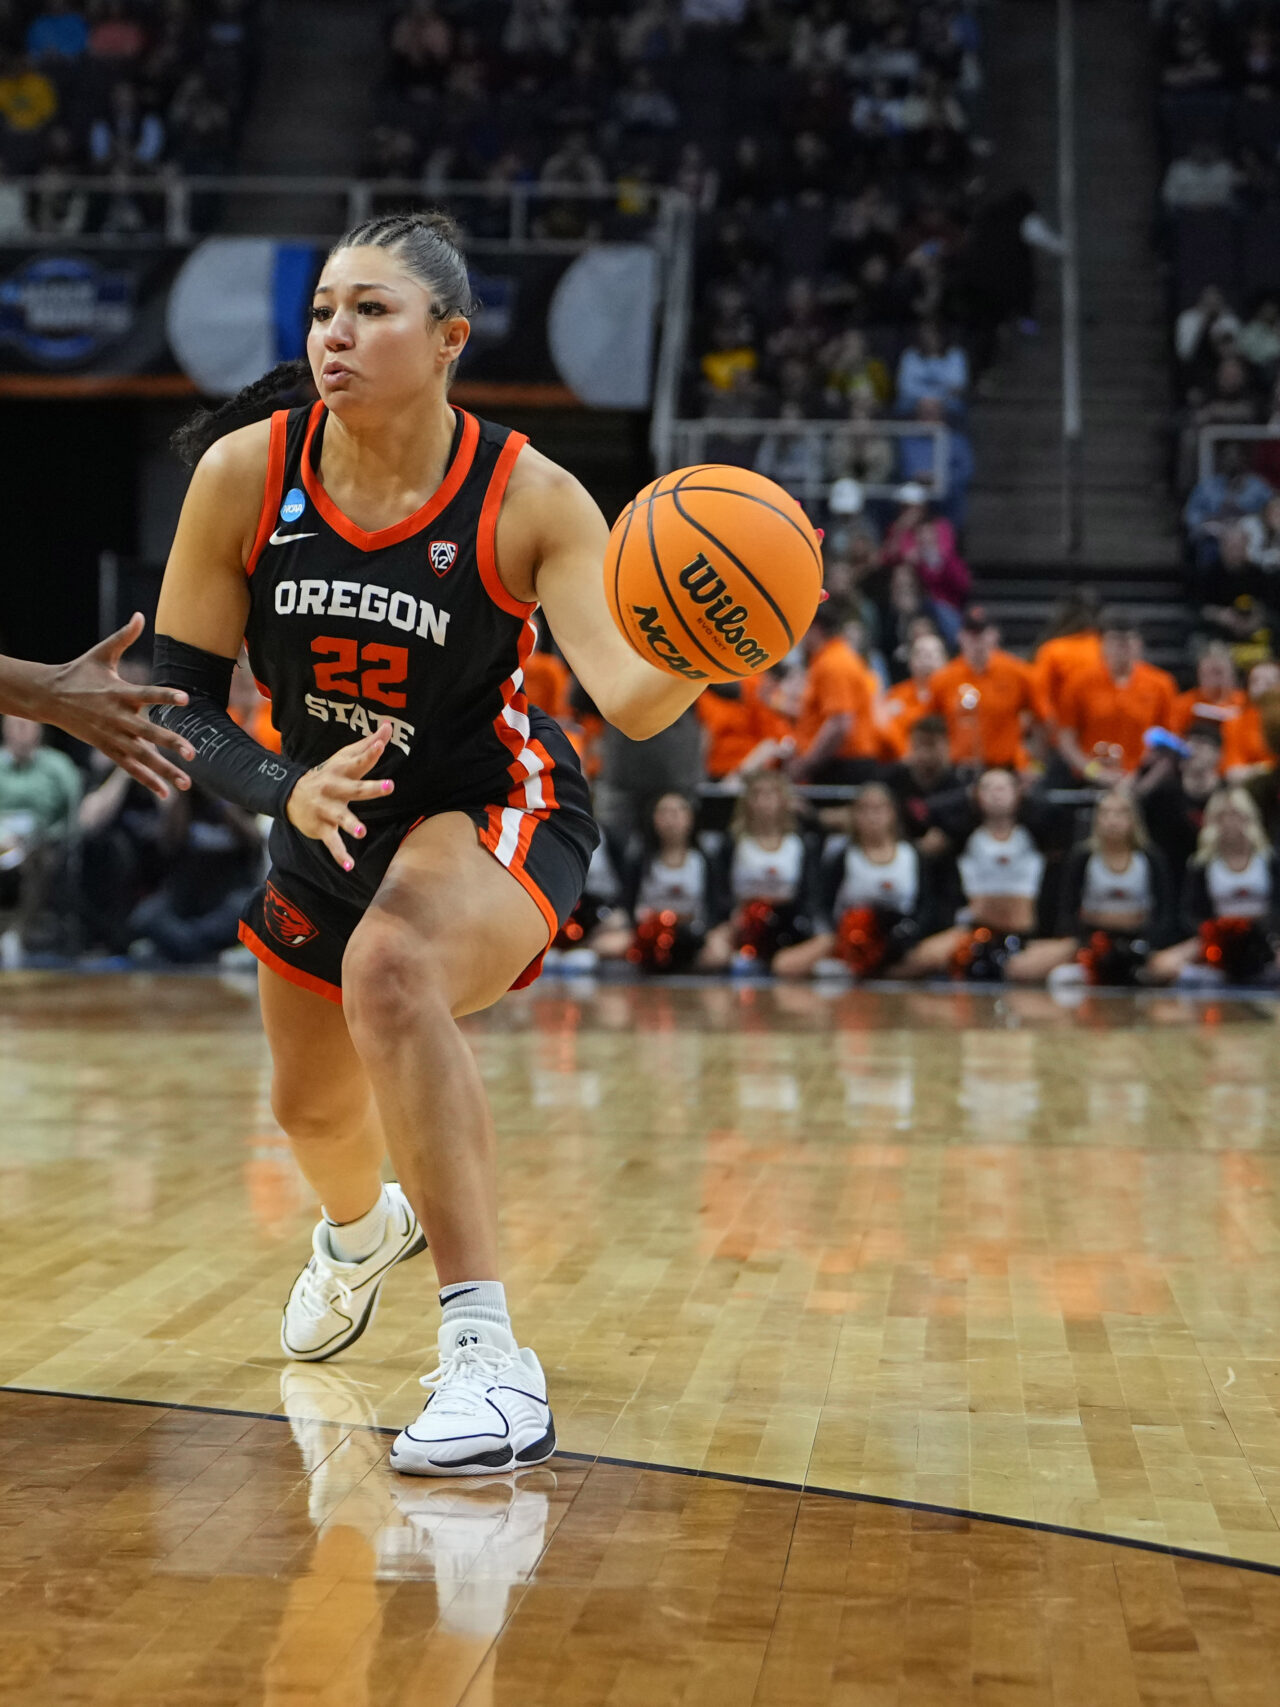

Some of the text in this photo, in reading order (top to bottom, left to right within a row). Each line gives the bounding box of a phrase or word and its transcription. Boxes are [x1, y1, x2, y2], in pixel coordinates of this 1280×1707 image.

[282, 503, 303, 514] NCAA
[430, 542, 456, 562] PAC
[434, 556, 448, 570] 12
[275, 579, 451, 646] OREGON
[632, 605, 710, 679] NCAA
[679, 552, 770, 669] Wilson
[696, 617, 713, 636] EVO
[310, 636, 409, 709] 22
[305, 693, 415, 756] STATE
